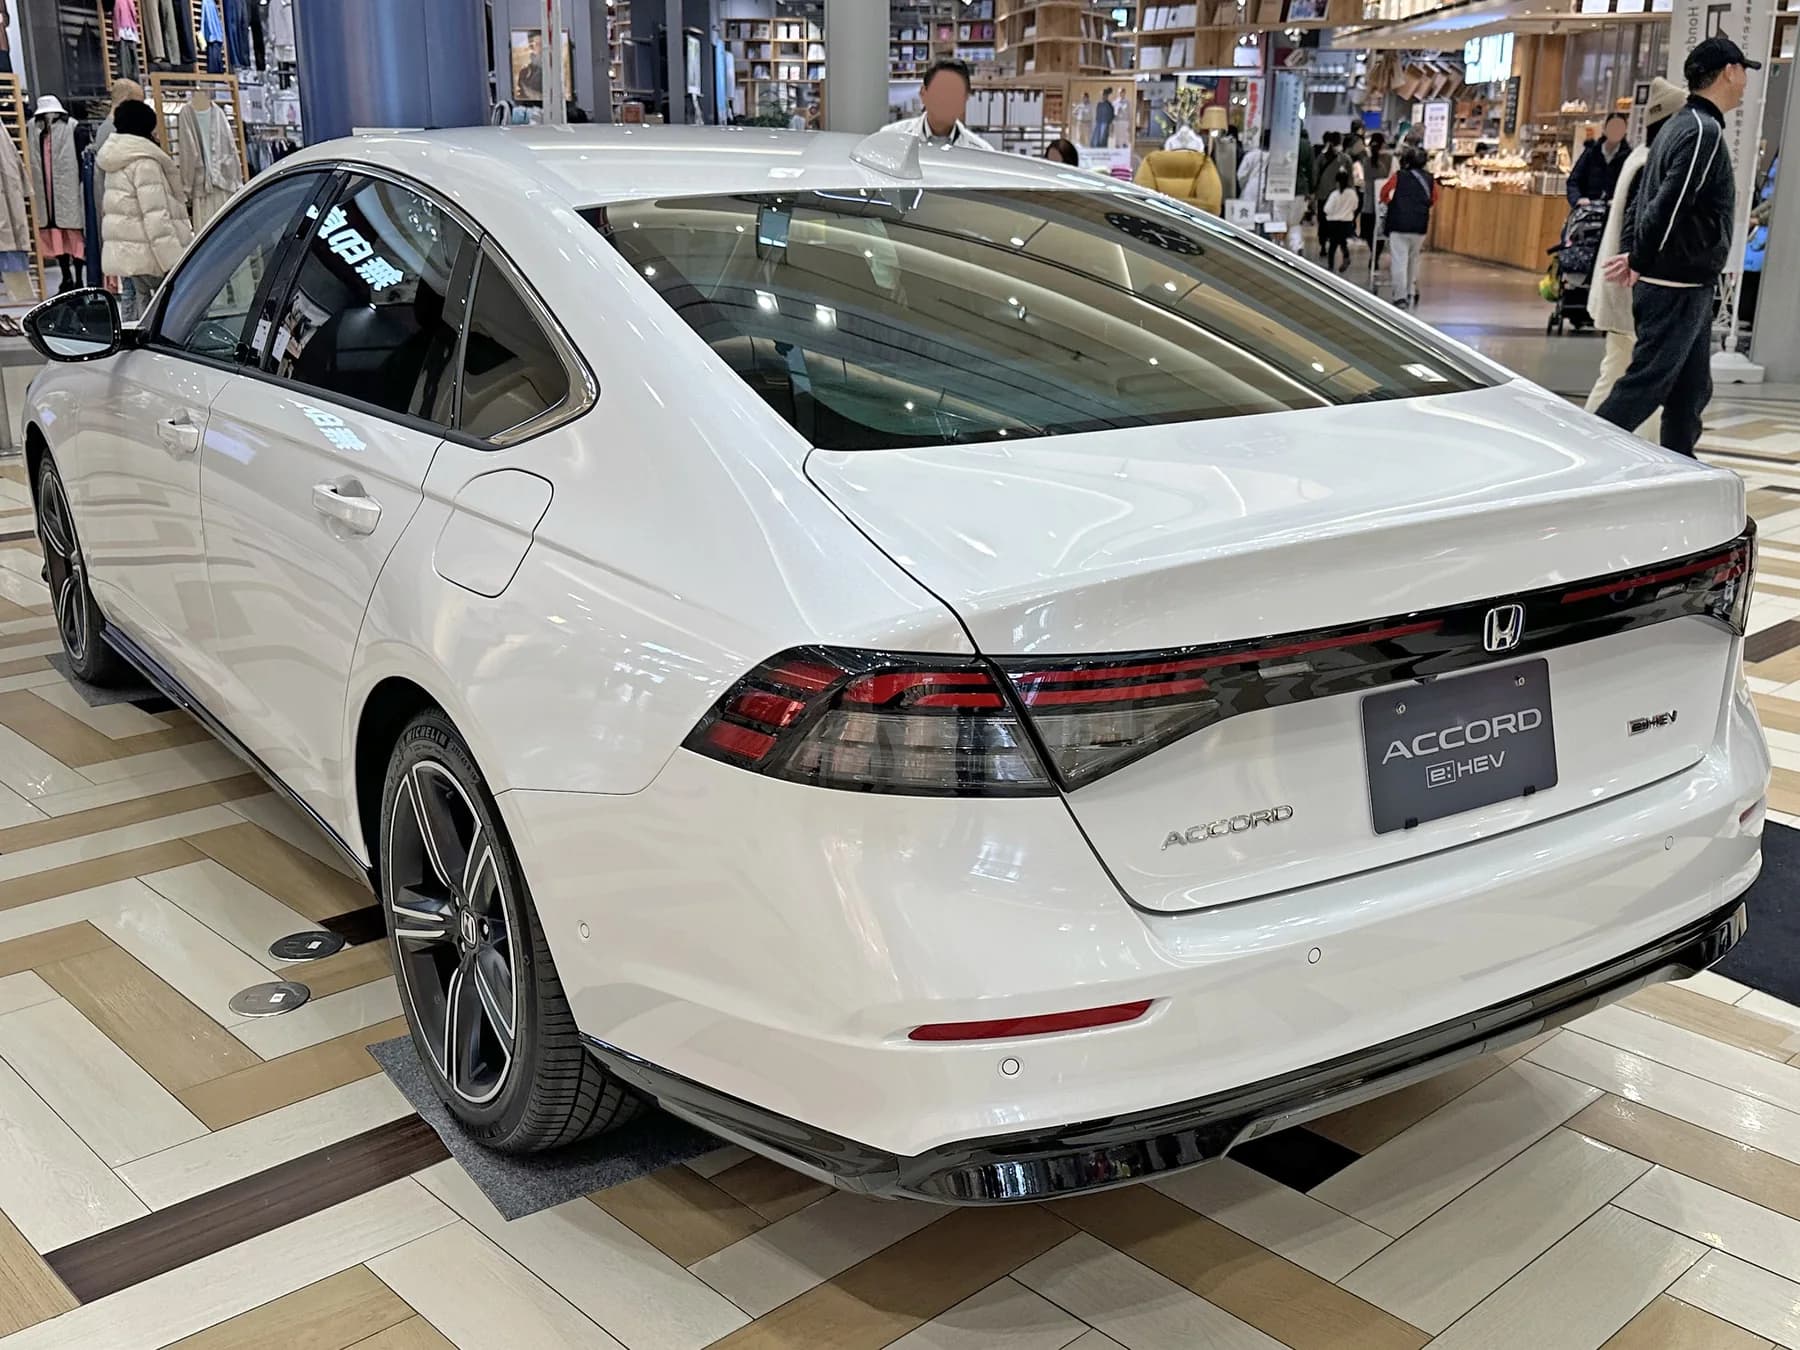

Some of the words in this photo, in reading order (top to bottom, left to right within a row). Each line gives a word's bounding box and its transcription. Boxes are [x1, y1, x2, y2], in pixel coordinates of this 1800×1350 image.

[1382, 708, 1542, 765] ACCORD
[1426, 750, 1506, 788] e:HEV
[1161, 805, 1293, 851] ACCORD
